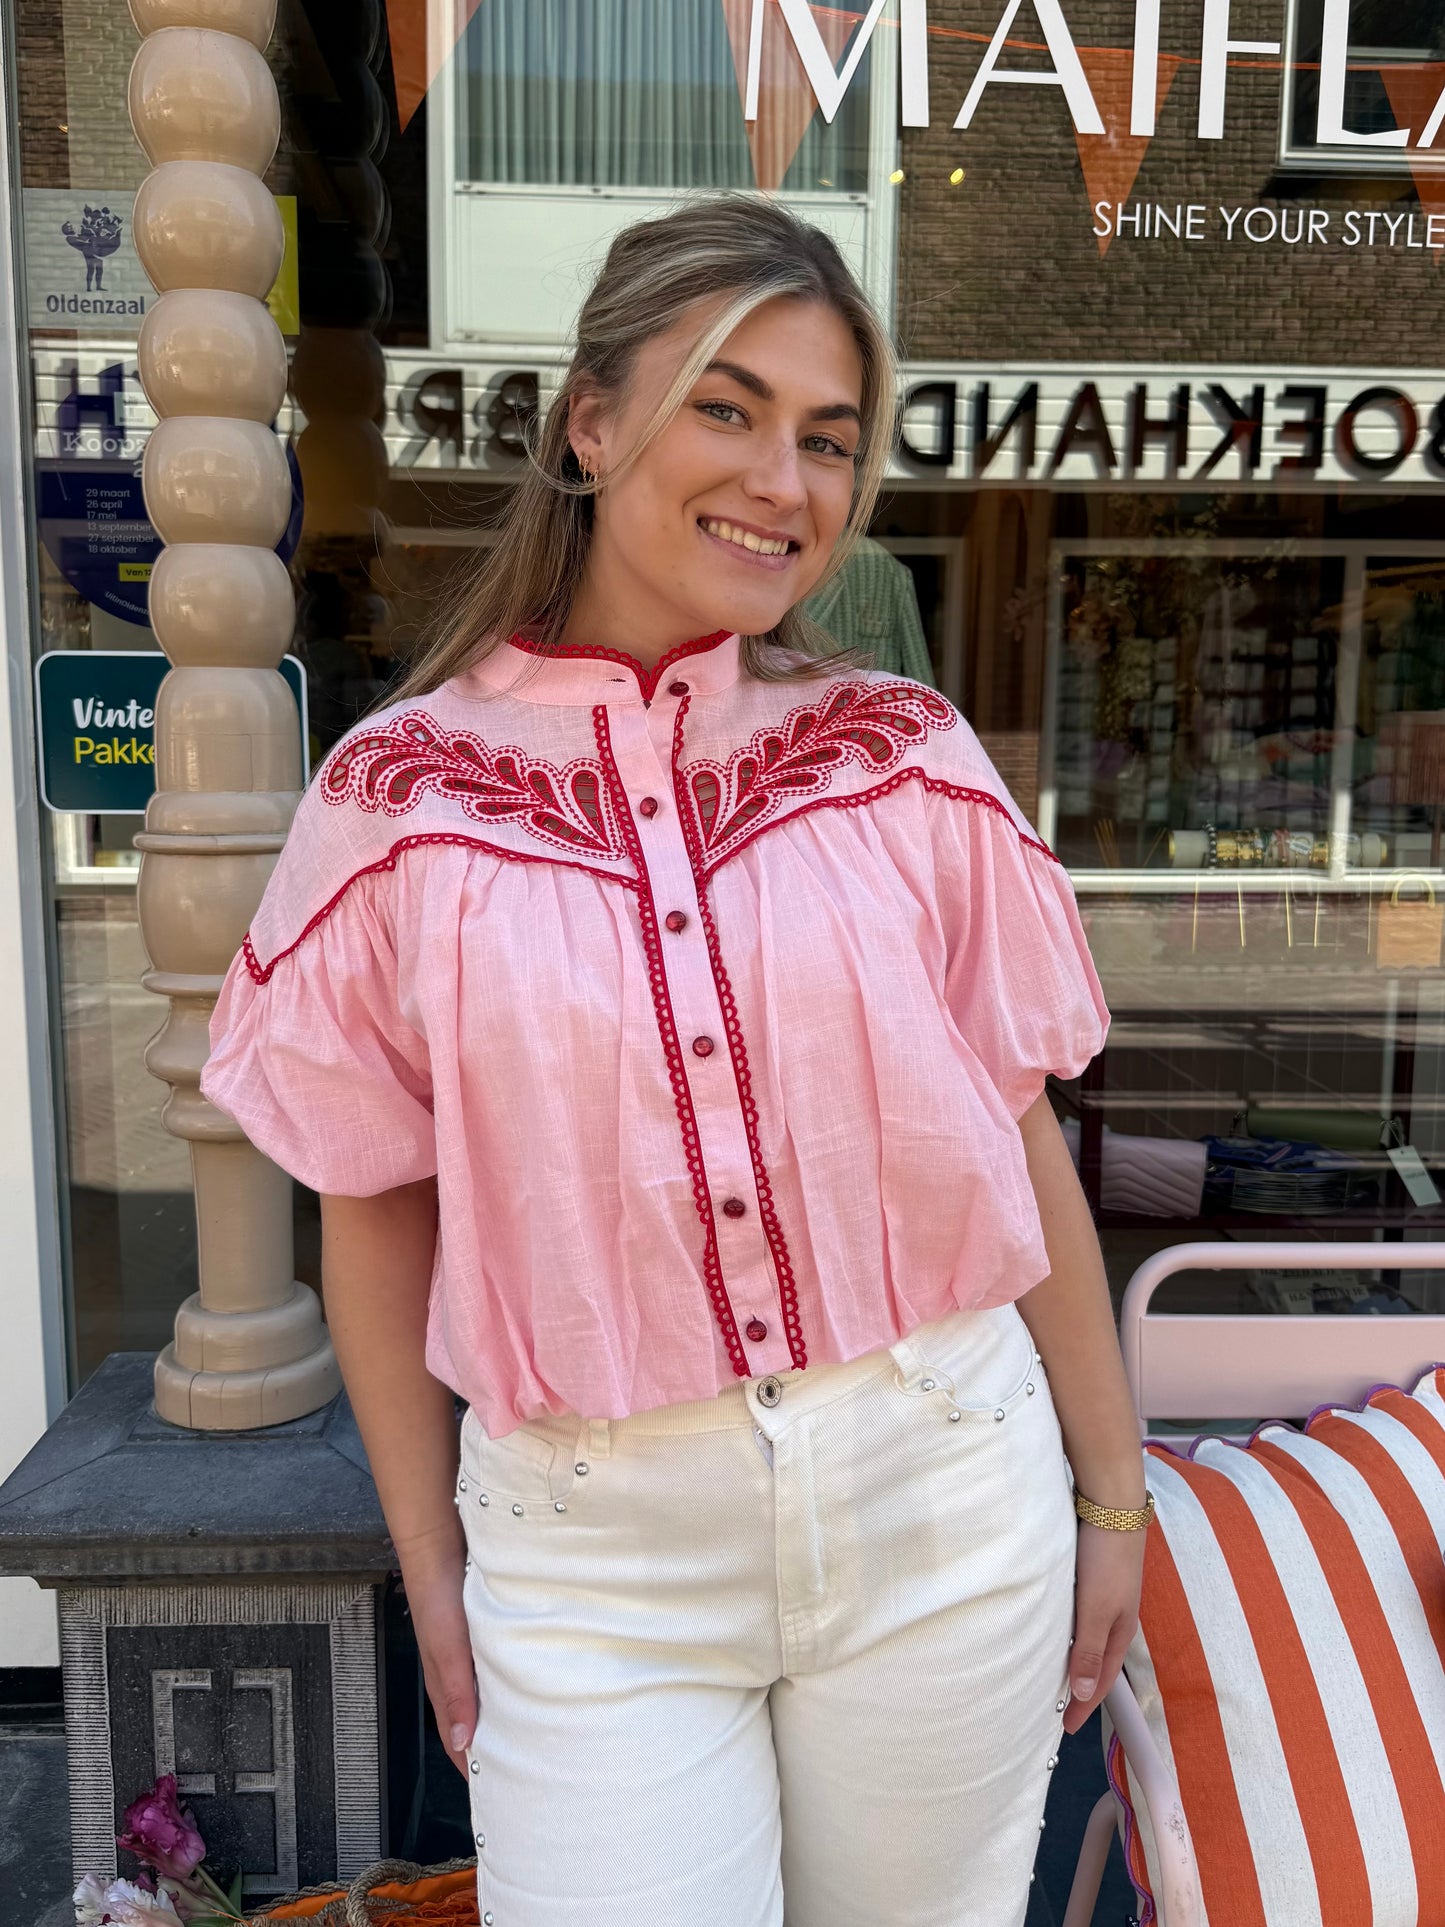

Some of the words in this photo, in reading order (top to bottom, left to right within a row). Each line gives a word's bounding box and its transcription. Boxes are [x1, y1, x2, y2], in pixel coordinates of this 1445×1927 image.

[1092, 200, 1207, 241] SHINE
[1218, 206, 1329, 244] YOUR
[1341, 210, 1445, 250] STYLE
[46, 293, 146, 315] Oldenzaal
[85, 488, 98, 498] 29
[100, 489, 131, 498] maart
[86, 499, 99, 509] 26
[100, 499, 123, 511] april
[87, 510, 96, 520] 17
[98, 510, 117, 521] mei
[87, 522, 97, 532] 13
[99, 522, 152, 534] september
[88, 533, 99, 543] 27
[101, 533, 155, 545] september
[100, 544, 138, 554] oktober
[126, 569, 143, 577] Van
